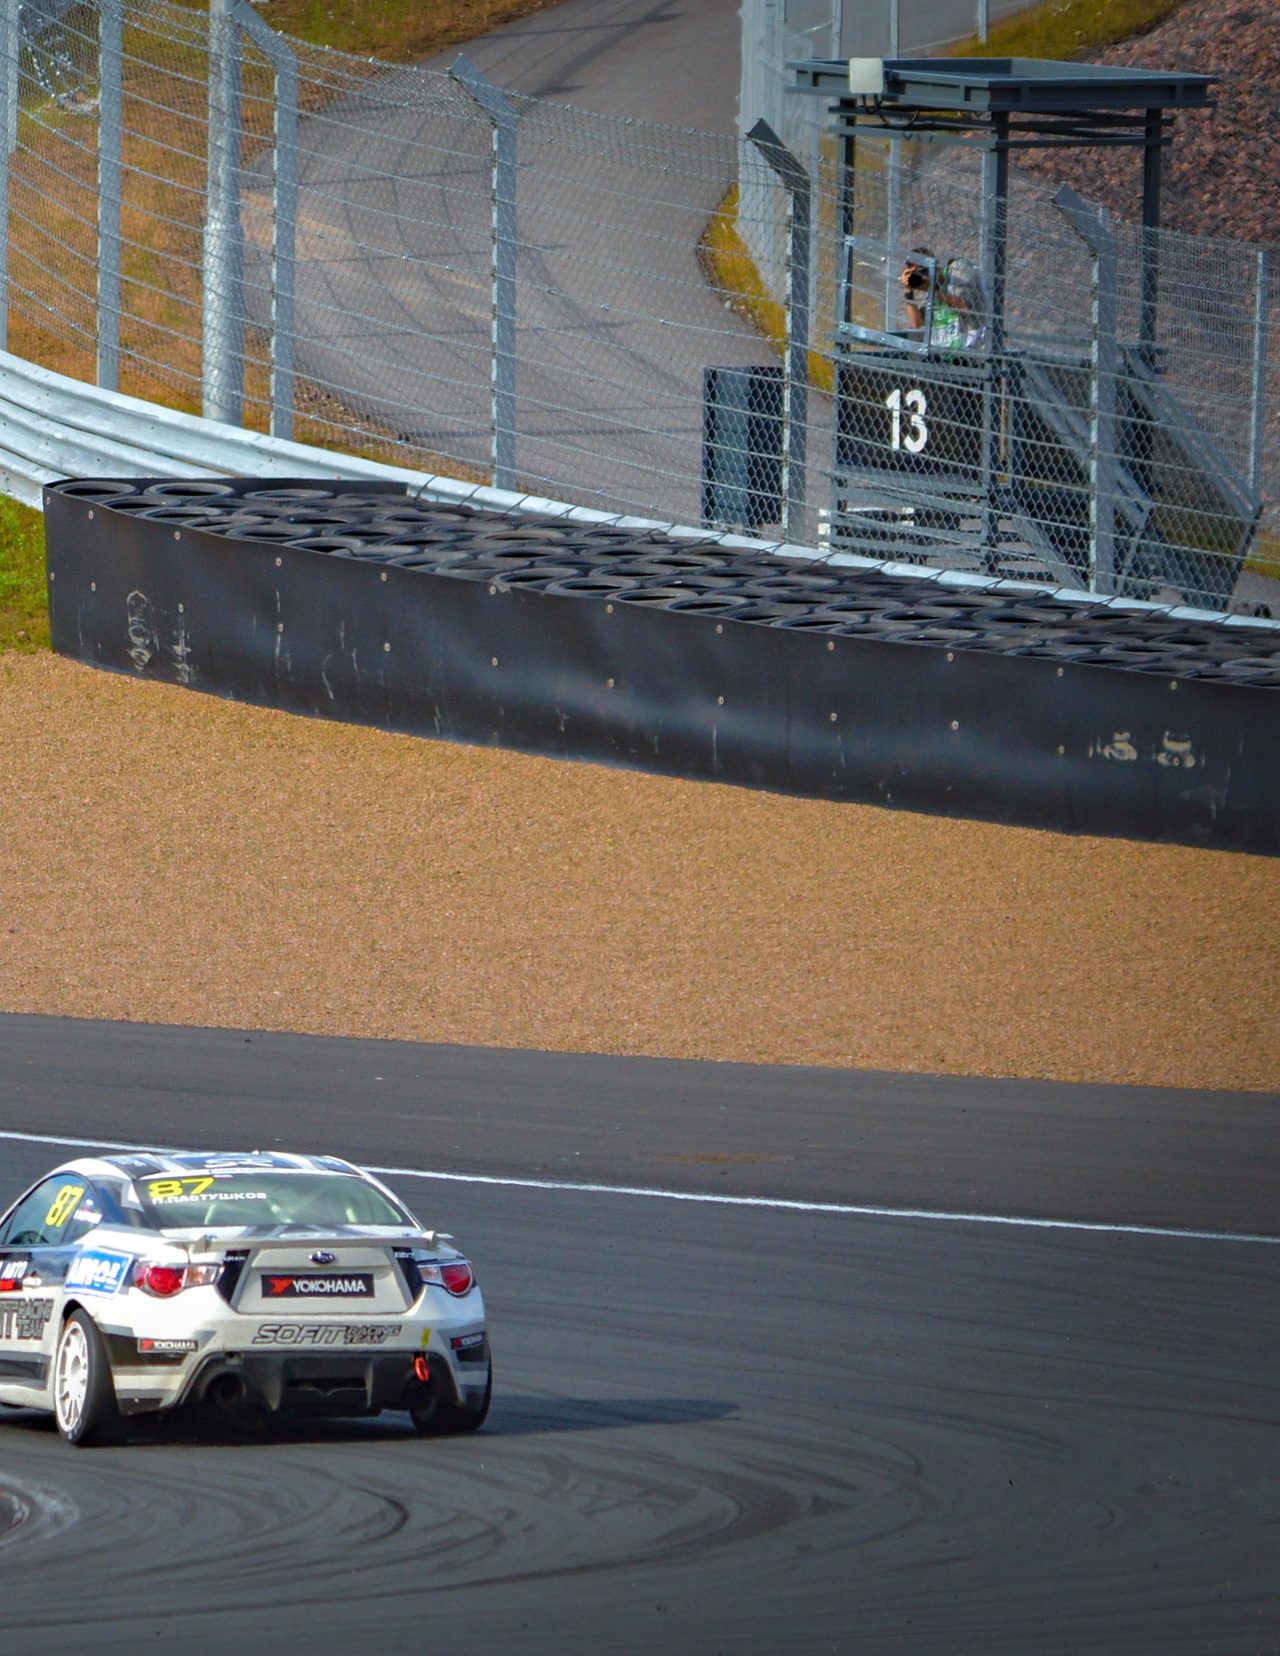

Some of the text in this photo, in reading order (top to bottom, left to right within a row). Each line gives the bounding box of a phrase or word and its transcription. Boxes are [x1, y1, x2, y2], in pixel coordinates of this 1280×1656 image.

[886, 389, 928, 453] 13
[148, 1177, 214, 1199] 87
[45, 1184, 85, 1227] 87
[292, 1279, 367, 1293] YOKOHAMA
[154, 1340, 196, 1350] YOKOHAMA
[251, 1323, 402, 1345] SOFIT RACING
[344, 1334, 387, 1345] TEAM
